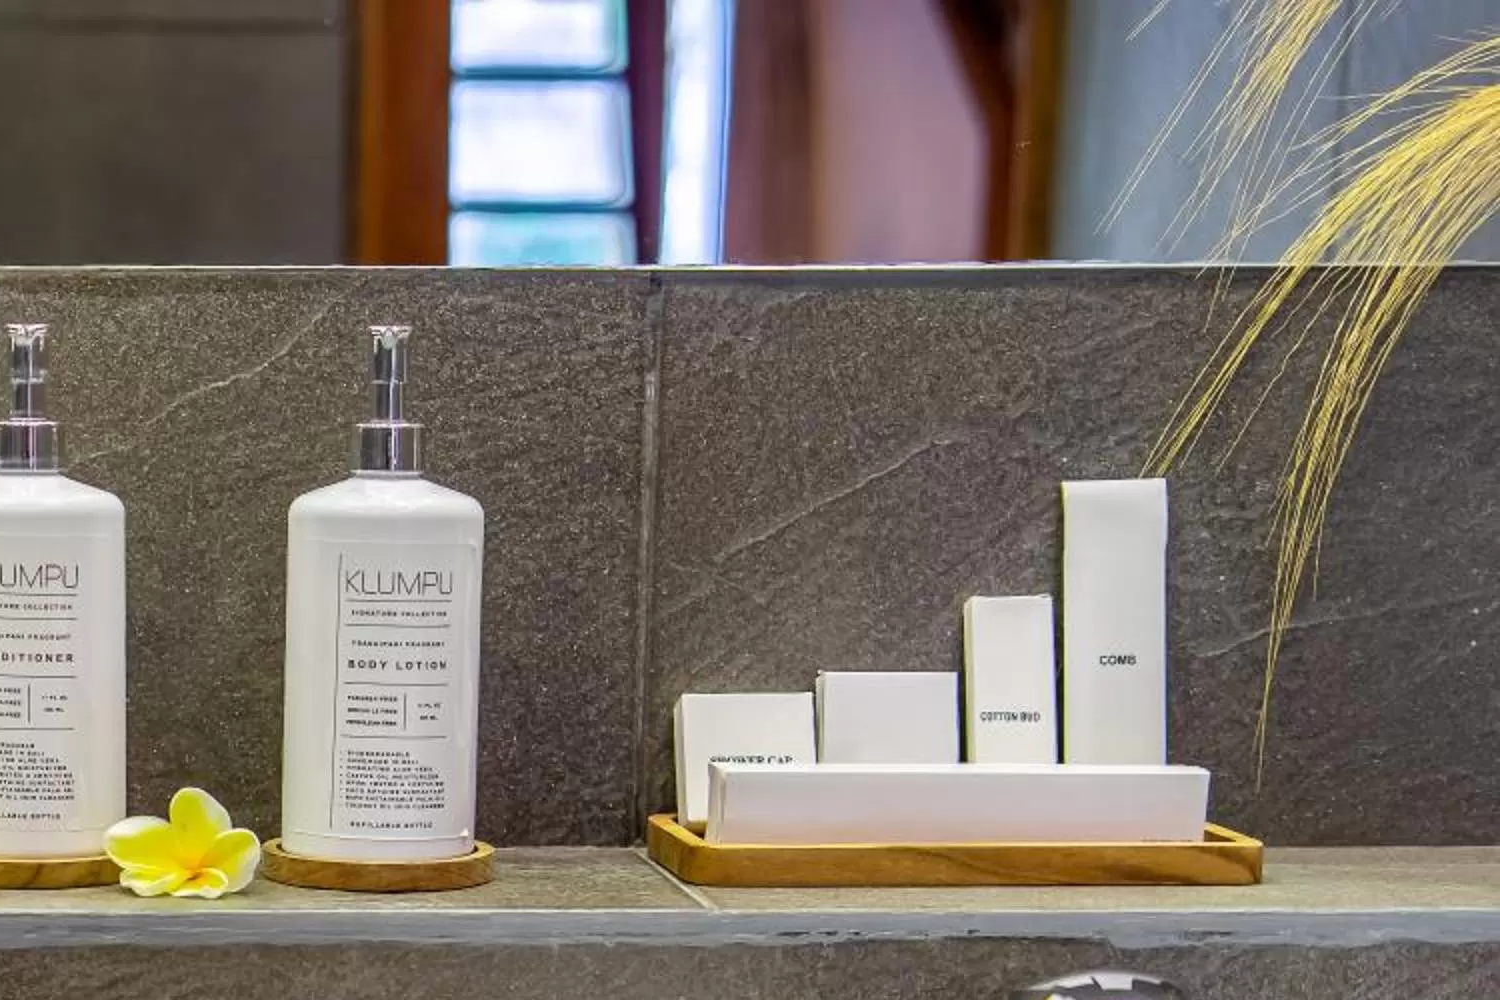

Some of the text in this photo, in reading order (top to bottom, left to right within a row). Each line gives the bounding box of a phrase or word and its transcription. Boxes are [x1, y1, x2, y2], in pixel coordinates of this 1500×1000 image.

[345, 569, 453, 596] KLUMPU
[347, 659, 448, 671] BODY LOTION
[1099, 654, 1137, 666] COMB
[980, 711, 1041, 723] COTTON BUD
